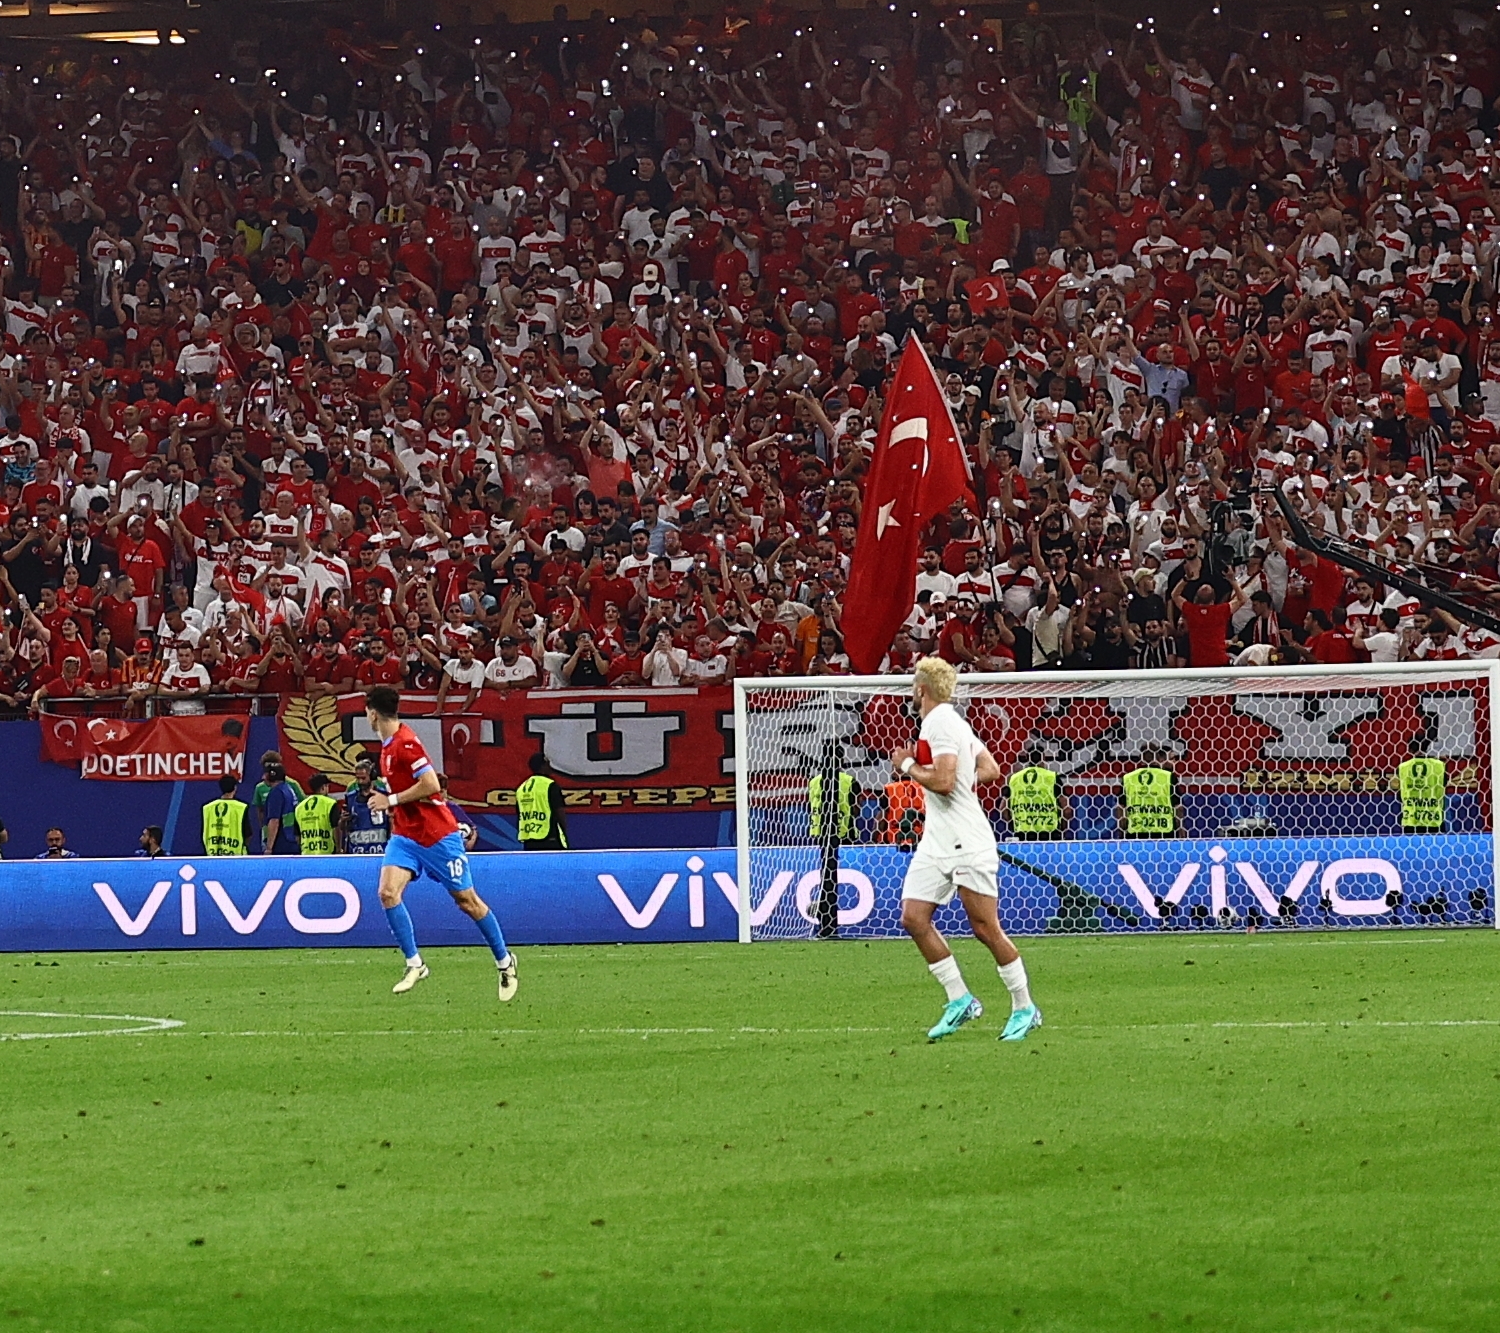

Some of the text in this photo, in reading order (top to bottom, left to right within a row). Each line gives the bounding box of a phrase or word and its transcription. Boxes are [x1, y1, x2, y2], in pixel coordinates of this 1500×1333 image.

[82, 750, 243, 780] DOETINCHEM
[486, 787, 736, 807] GZTEPE
[446, 857, 463, 878] 18
[598, 856, 875, 929] vivo
[1118, 845, 1402, 919] vivo
[92, 864, 361, 936] vivo
